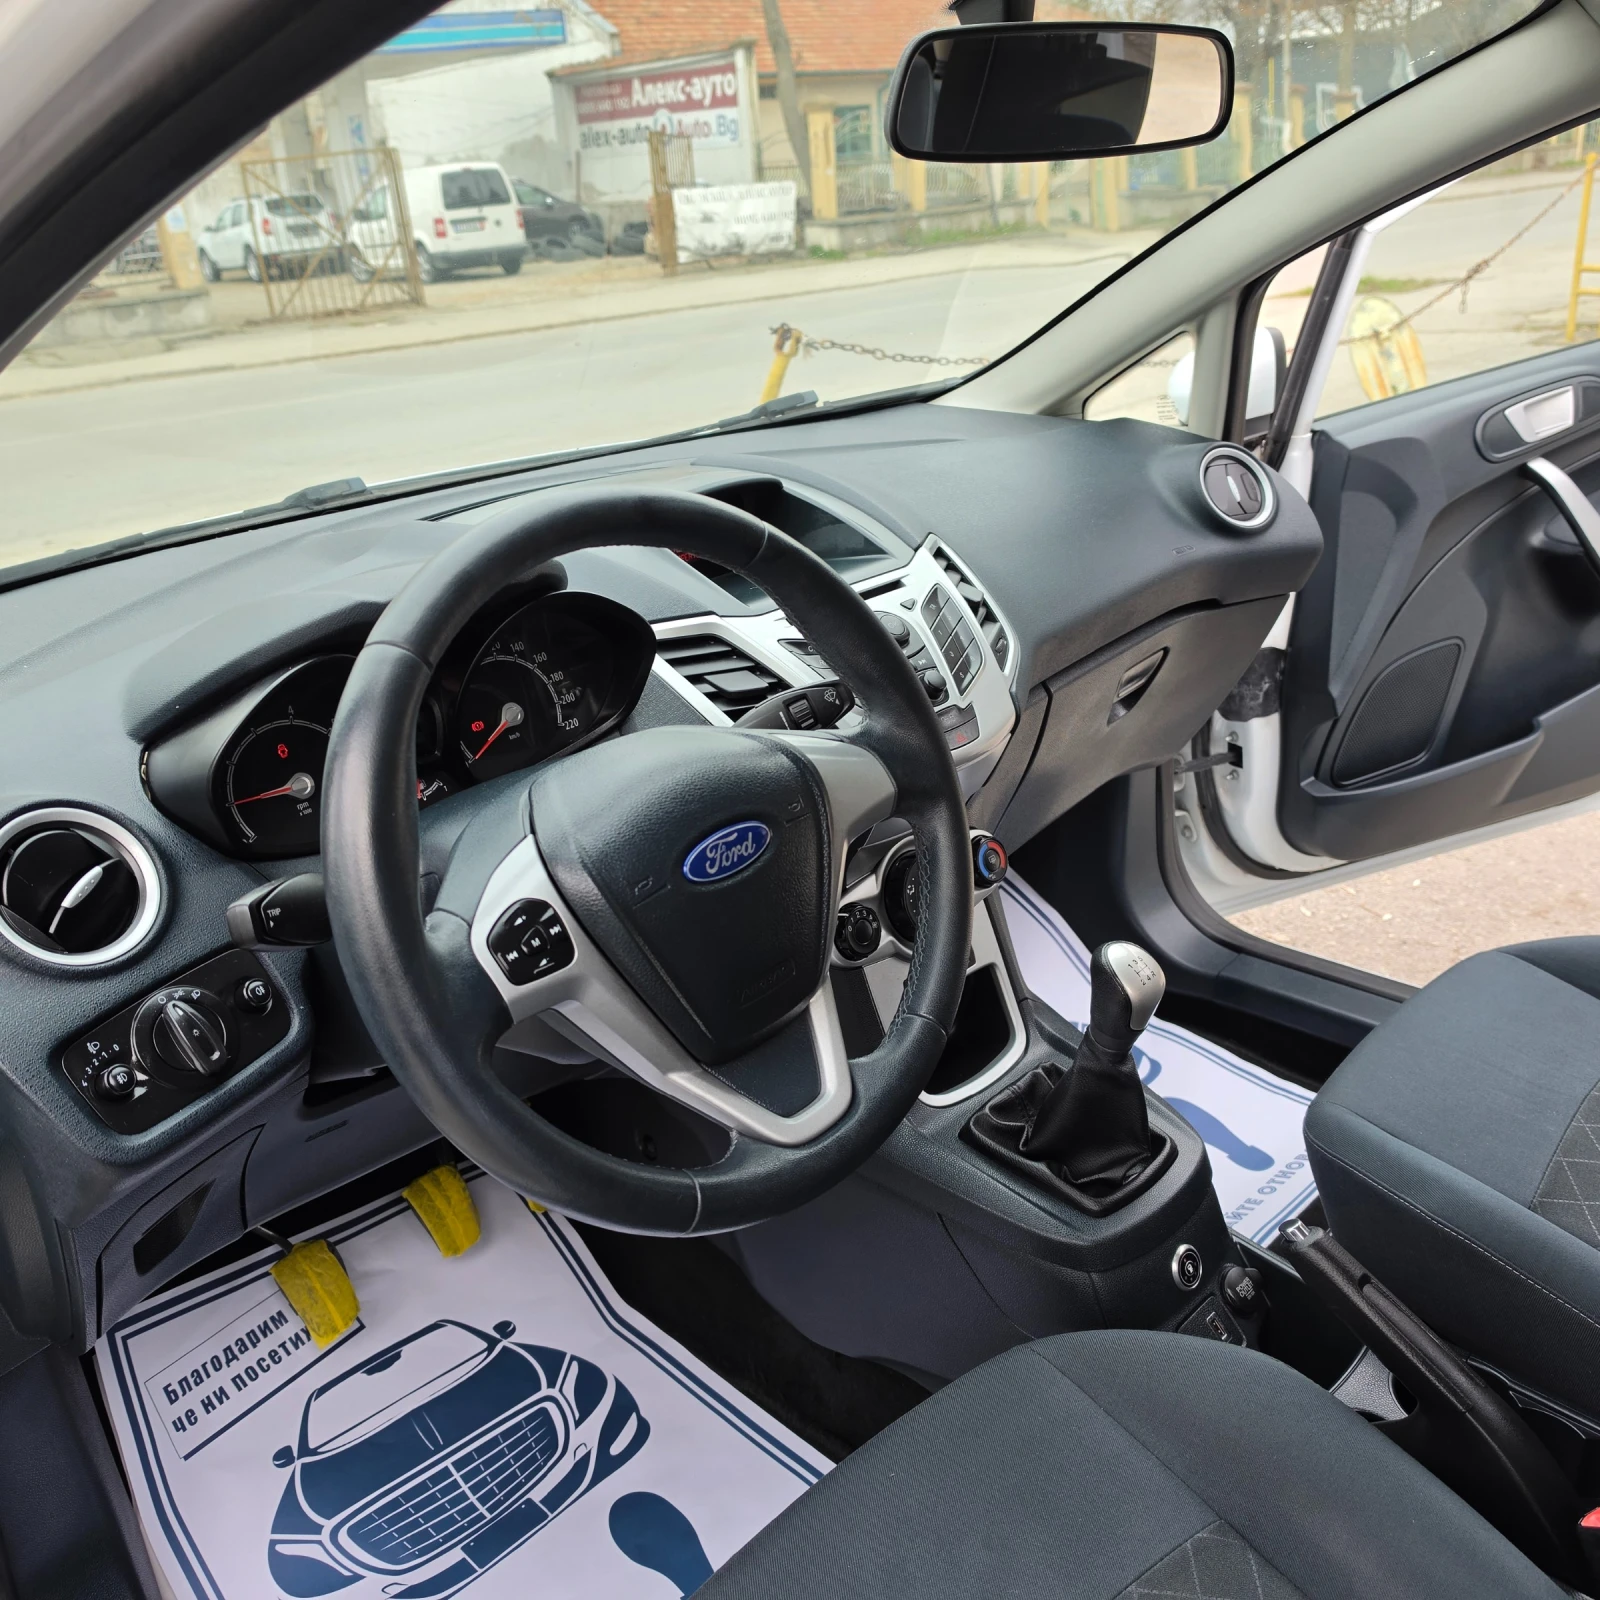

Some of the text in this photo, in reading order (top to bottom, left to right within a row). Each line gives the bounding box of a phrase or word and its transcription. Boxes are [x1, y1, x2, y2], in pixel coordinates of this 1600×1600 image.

[631, 73, 736, 107] Алекс-ауто
[510, 641, 525, 653] 140
[532, 651, 548, 664] 160
[549, 671, 564, 684] 180
[560, 692, 576, 705] 200
[287, 705, 294, 715] 4
[564, 717, 579, 731] 220
[296, 801, 309, 811] rpm
[705, 832, 756, 875] Ford
[266, 907, 282, 918] TRIP
[162, 1309, 289, 1406] Благодарим
[171, 1408, 199, 1433] че
[200, 1384, 231, 1416] ни
